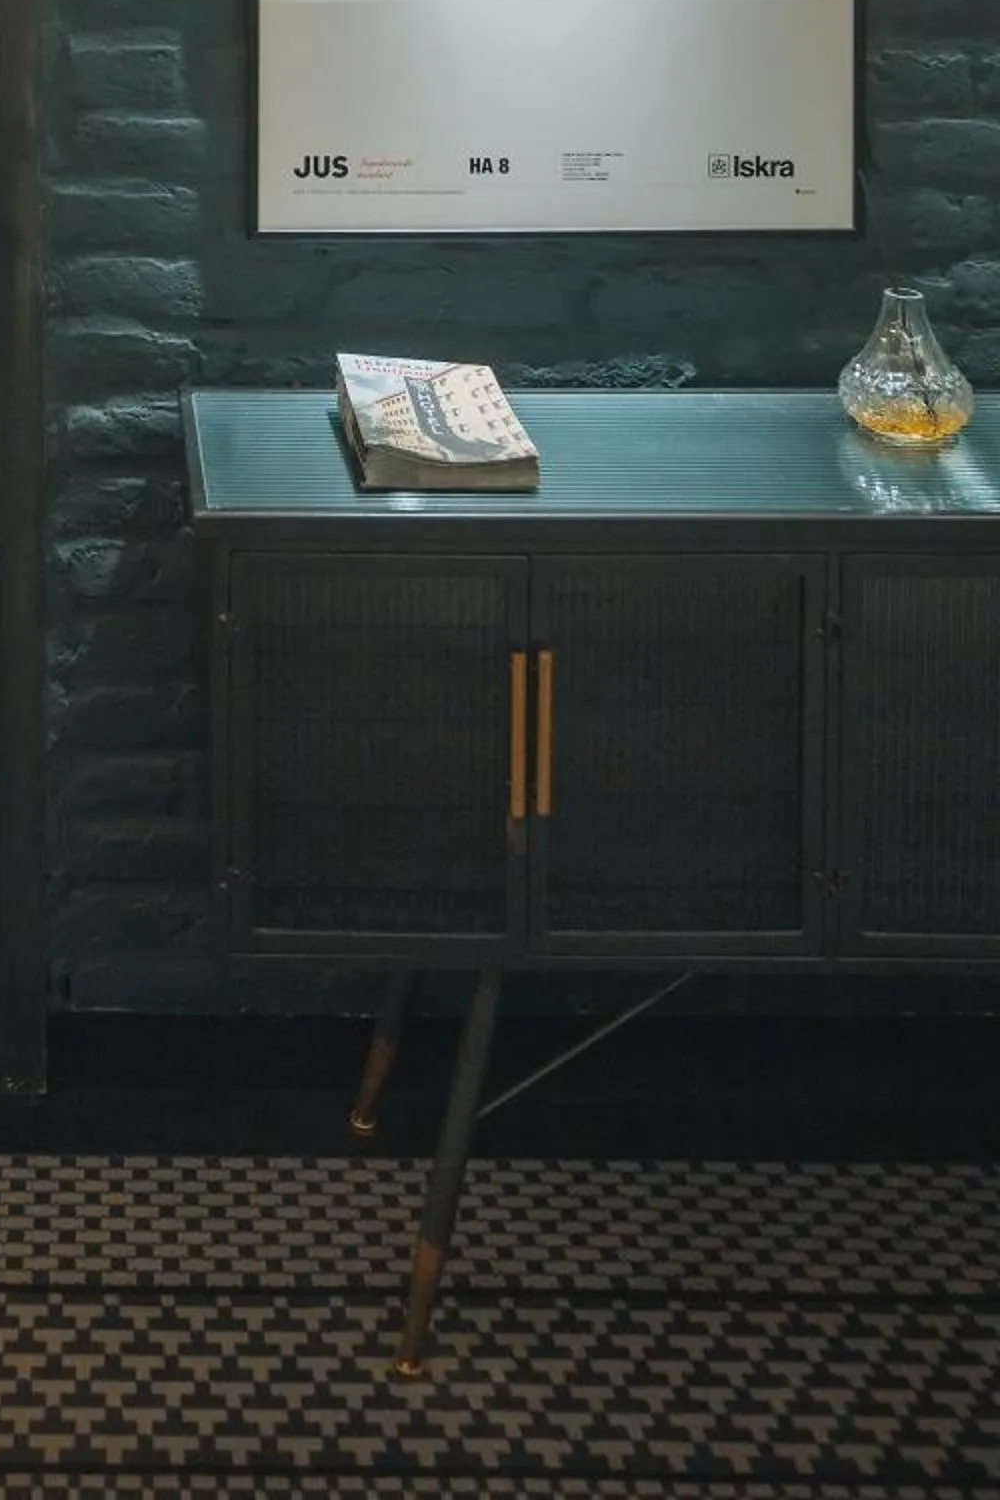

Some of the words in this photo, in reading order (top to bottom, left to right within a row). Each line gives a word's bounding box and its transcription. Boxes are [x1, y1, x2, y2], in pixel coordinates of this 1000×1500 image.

[293, 155, 349, 178] JUS
[469, 158, 493, 174] HA
[498, 158, 509, 174] 8
[733, 155, 795, 178] Iskra
